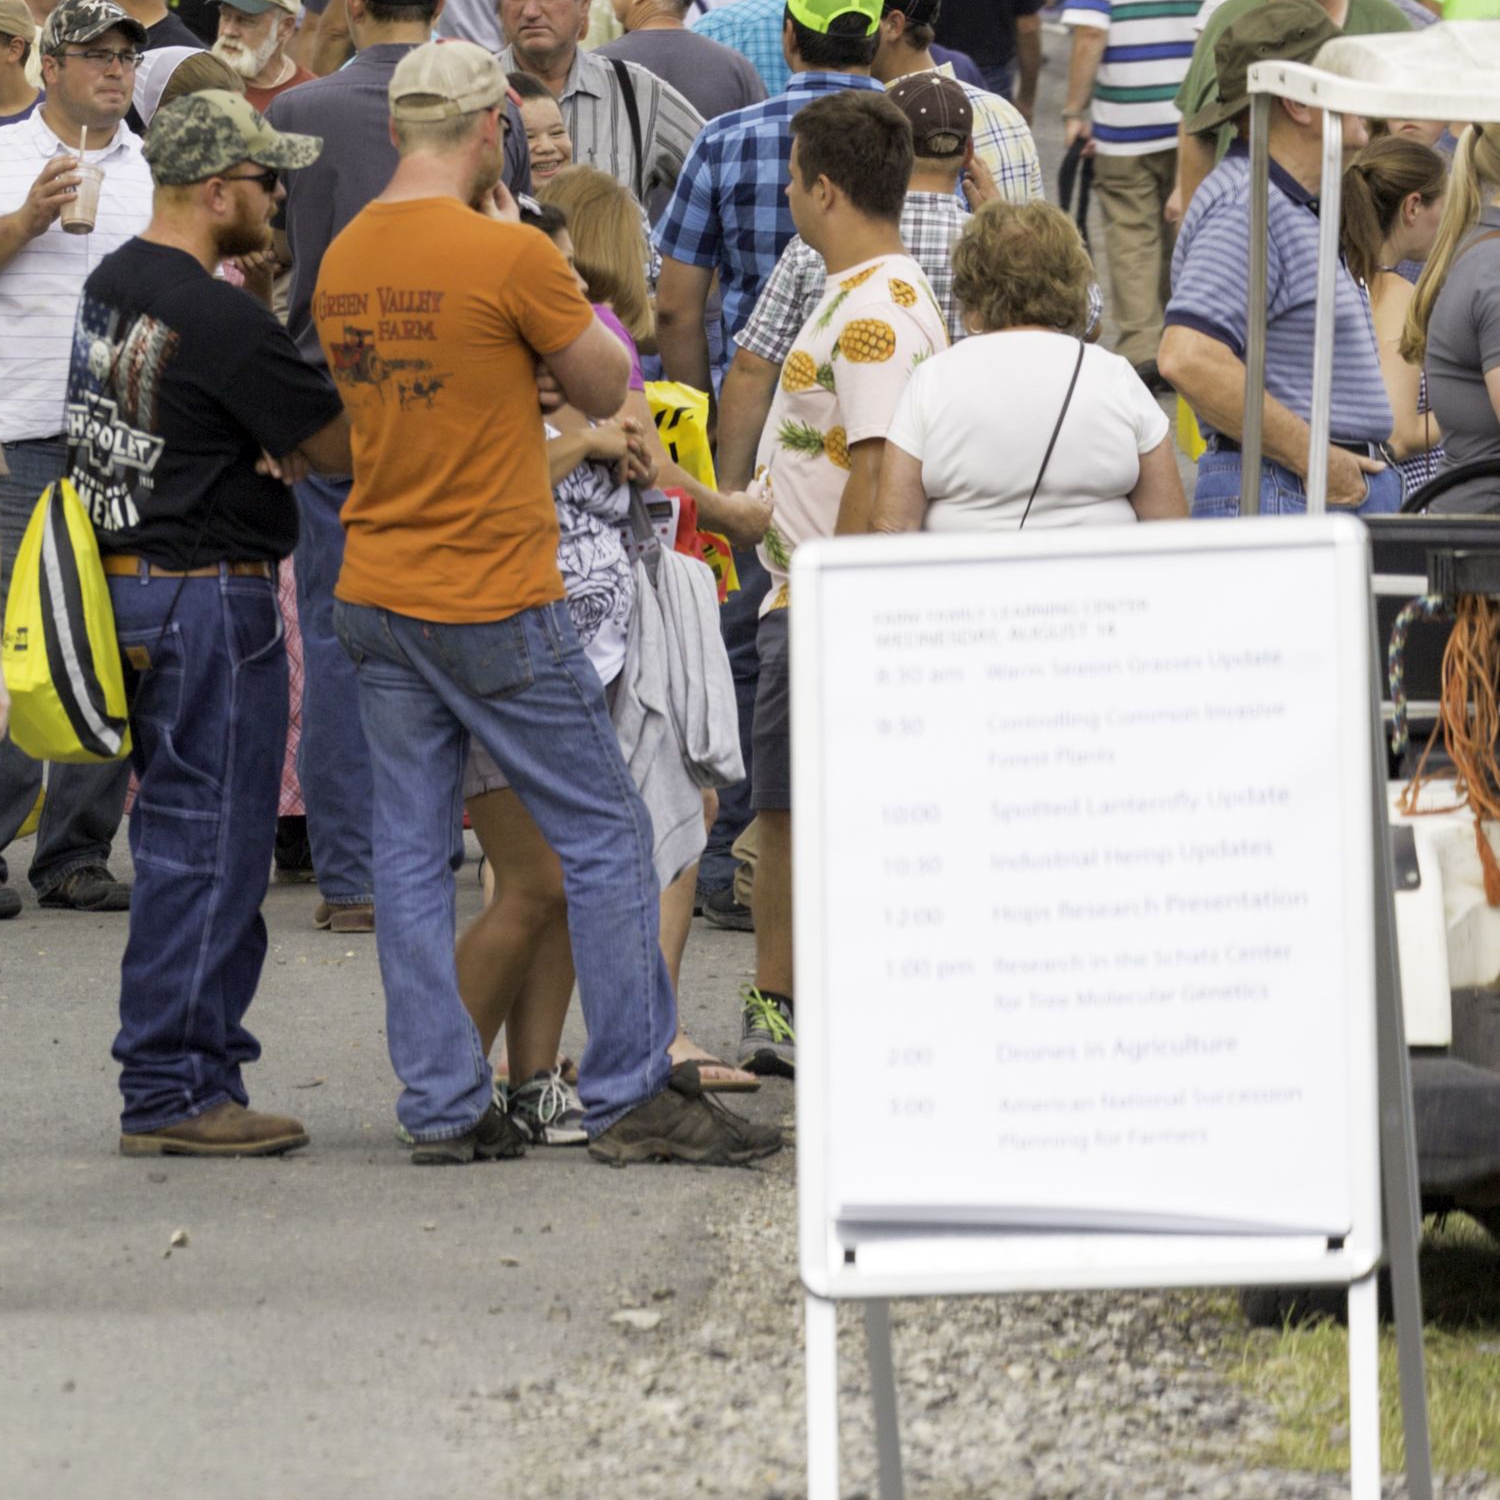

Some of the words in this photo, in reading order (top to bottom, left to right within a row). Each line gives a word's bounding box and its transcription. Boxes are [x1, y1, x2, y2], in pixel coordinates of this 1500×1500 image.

[375, 285, 445, 318] VALLEY
[377, 319, 438, 342] FARM
[1206, 648, 1283, 671] Update
[985, 708, 1100, 735] Controlling
[1053, 746, 1116, 767] Plants
[990, 796, 1081, 822] Spotted
[1085, 789, 1201, 816] Lanternfly
[1206, 784, 1290, 809] Update
[989, 847, 1099, 871] Industrial
[1103, 844, 1174, 871] Hemp
[1178, 837, 1275, 867] Updates
[1056, 897, 1161, 920] Research
[1164, 890, 1309, 915] Presentation
[993, 952, 1085, 975] Research
[1113, 949, 1146, 969] the
[1223, 942, 1292, 964] Center
[994, 991, 1023, 1010] for
[1028, 989, 1069, 1009] Tree
[1074, 985, 1176, 1007] Molecular
[1179, 981, 1270, 1002] Genetics
[995, 1041, 1077, 1063] Drones
[1084, 1039, 1106, 1058] in
[1112, 1032, 1240, 1063] Agriculture
[998, 1093, 1095, 1113] American
[1101, 1088, 1187, 1110] National
[1192, 1084, 1304, 1107] Succession
[998, 1129, 1089, 1154] Planning
[1093, 1128, 1123, 1147] for
[1127, 1127, 1210, 1148] Farmers
